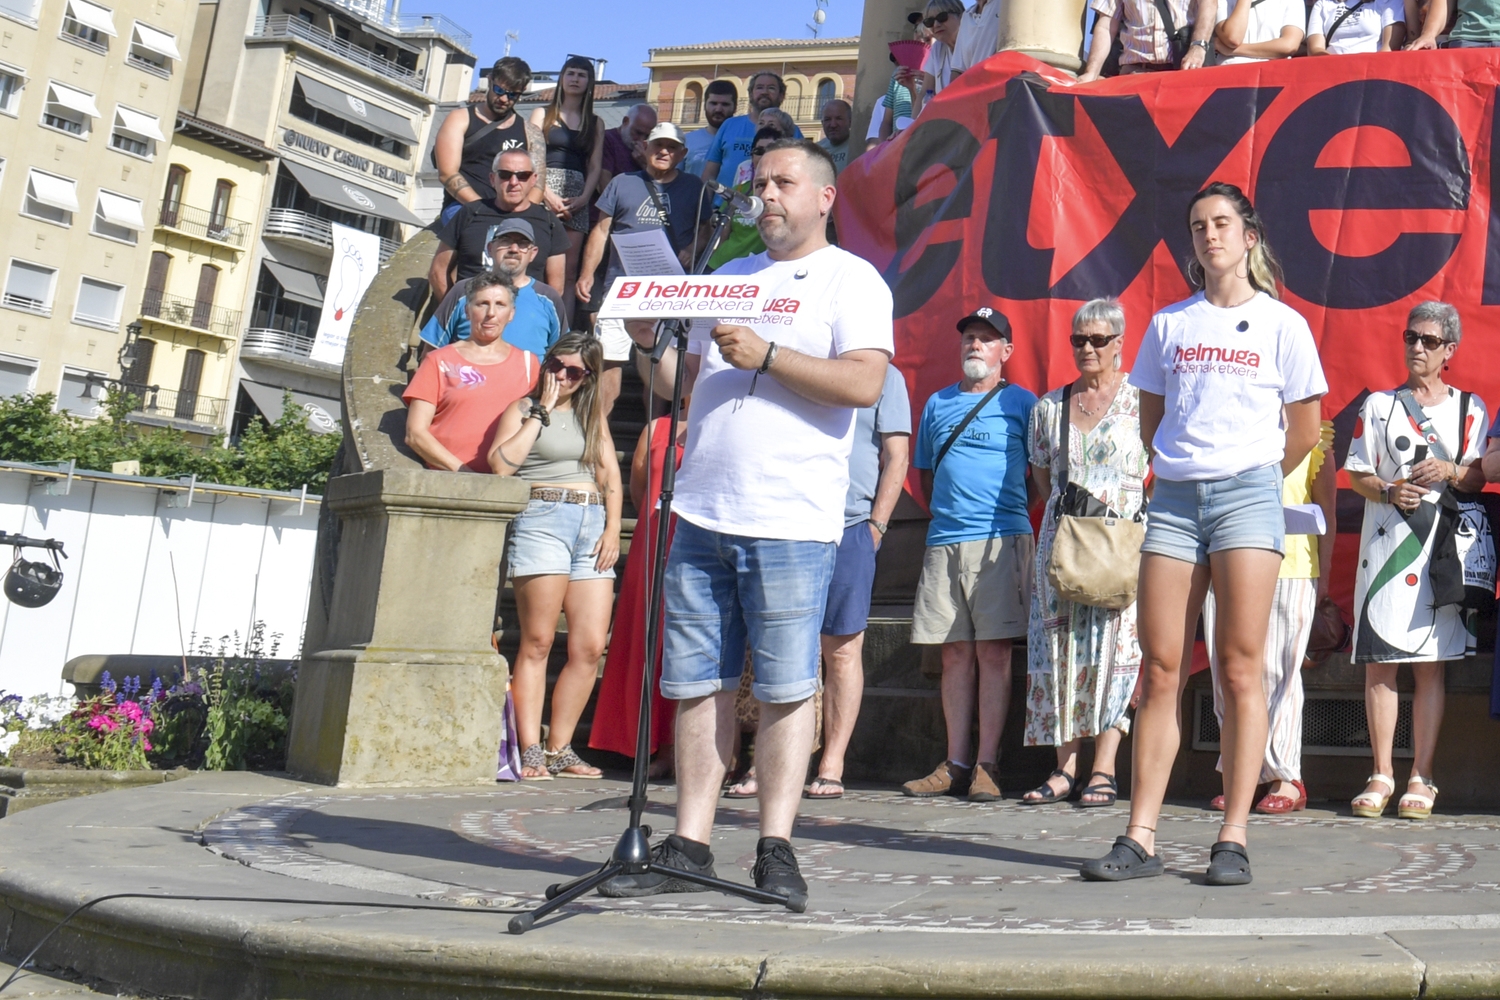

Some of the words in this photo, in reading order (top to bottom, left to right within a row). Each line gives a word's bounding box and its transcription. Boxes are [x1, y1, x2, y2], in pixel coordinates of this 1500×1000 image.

[295, 132, 330, 158] NUEVO
[333, 150, 370, 172] CASINO
[372, 162, 407, 185] ESLAVA
[644, 281, 760, 299] helmuga
[638, 299, 695, 311] denak
[696, 299, 754, 311] etxera
[753, 313, 793, 326] etxera
[1172, 343, 1260, 368] helmuga
[1180, 362, 1217, 374] denak
[1218, 363, 1258, 380] etxera
